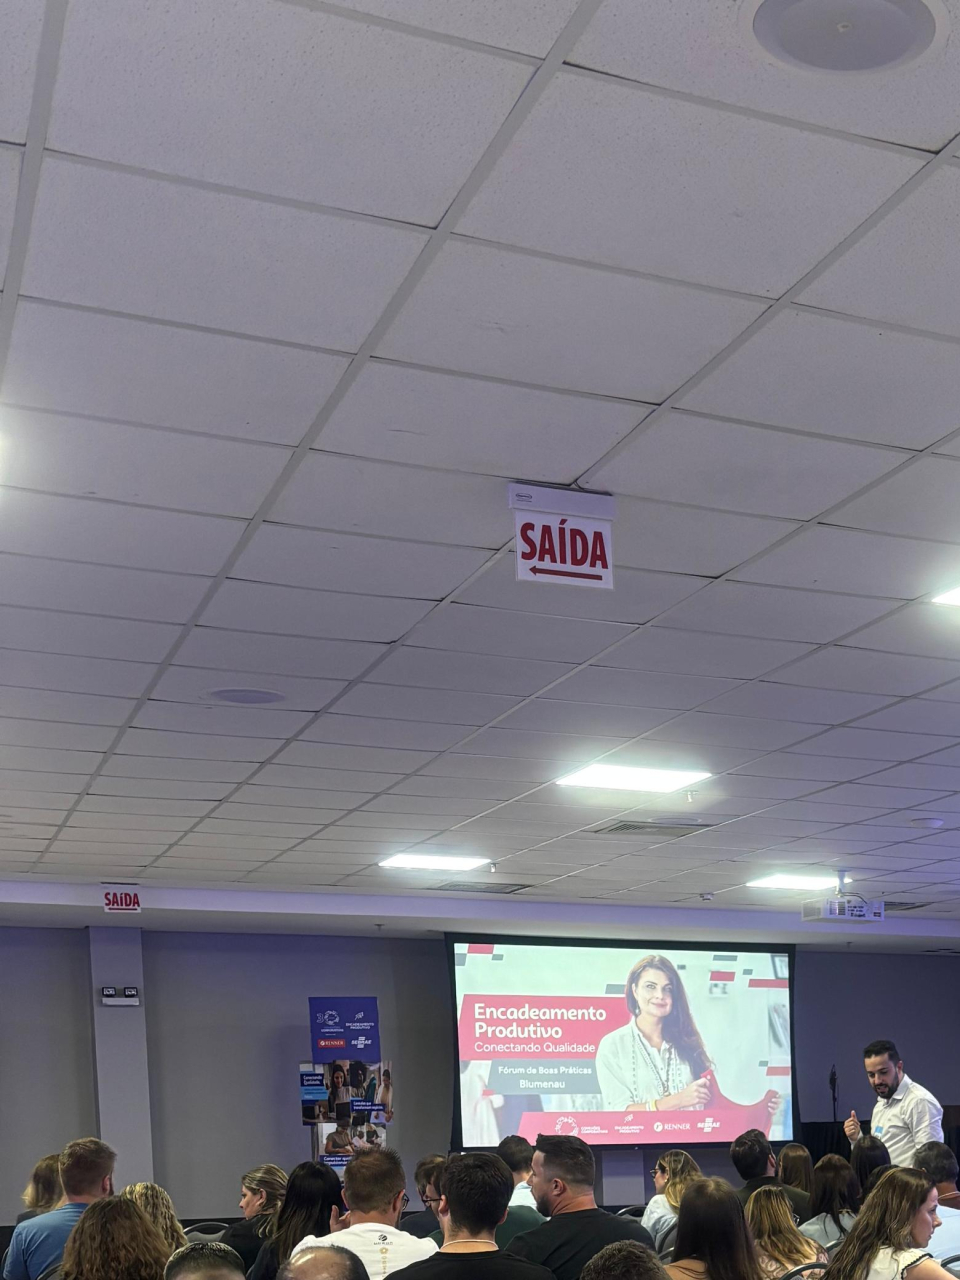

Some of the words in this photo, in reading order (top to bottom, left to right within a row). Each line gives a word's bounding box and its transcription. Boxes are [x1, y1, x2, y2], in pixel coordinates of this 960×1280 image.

[520, 519, 608, 569] SAÍDA
[474, 1003, 607, 1021] Encadeamento
[475, 1022, 563, 1038] Produtivo
[474, 1041, 541, 1052] Conectando
[543, 1042, 596, 1052] Qualidade
[498, 1065, 525, 1074] Fórum
[526, 1066, 537, 1074] de
[538, 1066, 558, 1074] Boas
[559, 1066, 592, 1074] Práticas
[519, 1079, 565, 1088] Blumenau
